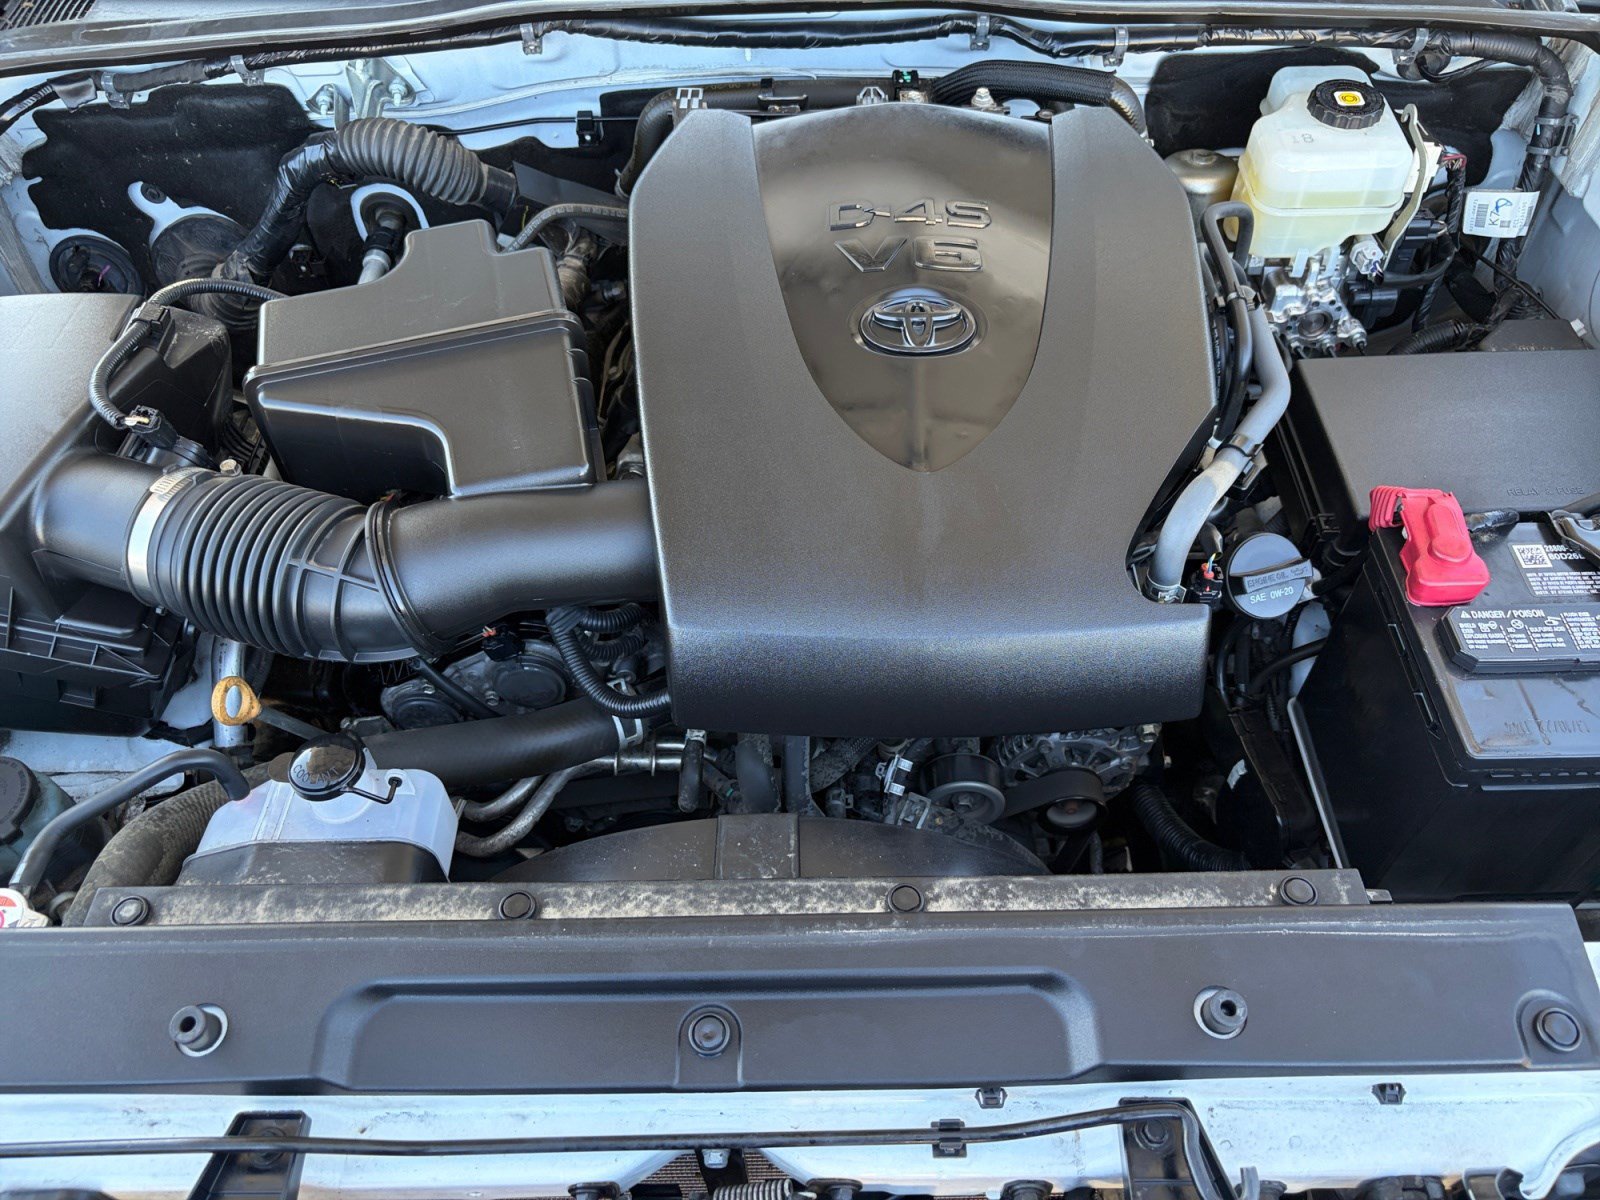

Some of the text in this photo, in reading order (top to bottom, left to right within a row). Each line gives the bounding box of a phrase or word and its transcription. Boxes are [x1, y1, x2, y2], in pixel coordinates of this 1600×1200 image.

[829, 198, 992, 231] D-4S
[834, 235, 983, 272] V6
[1506, 487, 1540, 497] RELAY
[1556, 486, 1585, 496] FUSE
[1276, 570, 1289, 581] OIL
[1250, 586, 1294, 604] SAE 0W-20
[1470, 610, 1506, 619] DANGER
[1512, 609, 1545, 618] POISON
[293, 764, 341, 785] COOLANT
